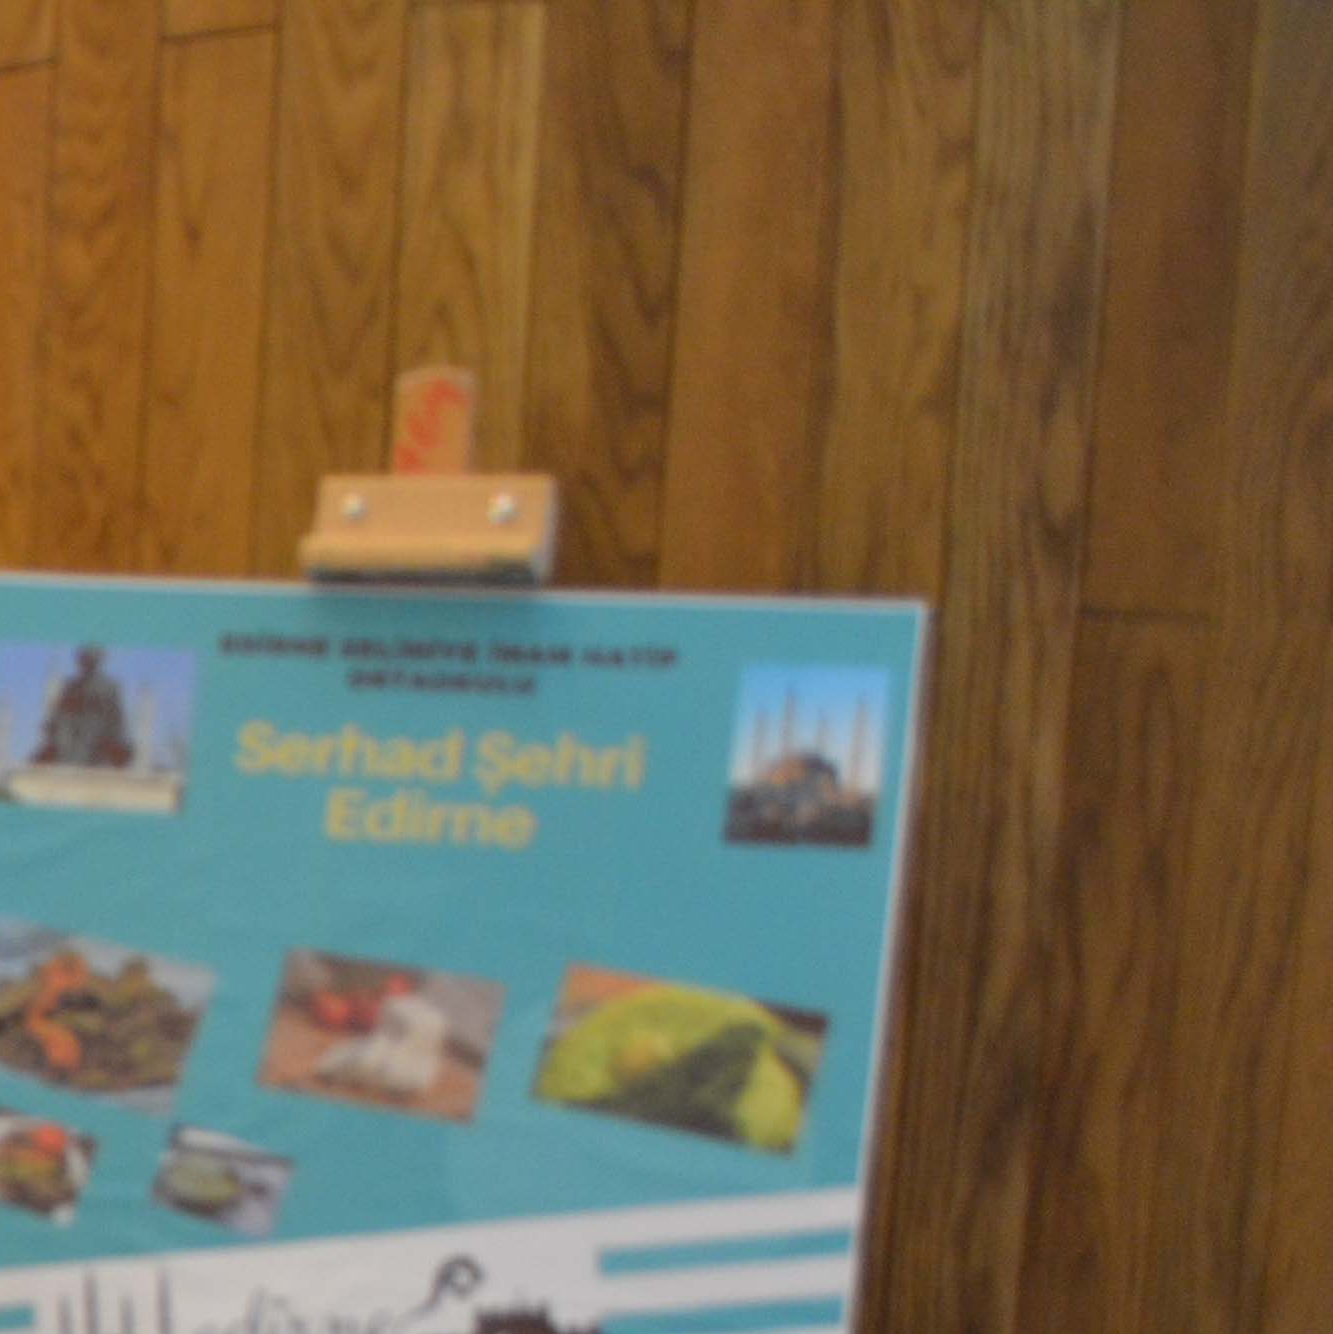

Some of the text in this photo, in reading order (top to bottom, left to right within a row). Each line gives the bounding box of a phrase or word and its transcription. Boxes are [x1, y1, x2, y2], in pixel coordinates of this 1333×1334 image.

[236, 719, 646, 796] Serhad Şehri
[326, 787, 540, 851] Edirne
